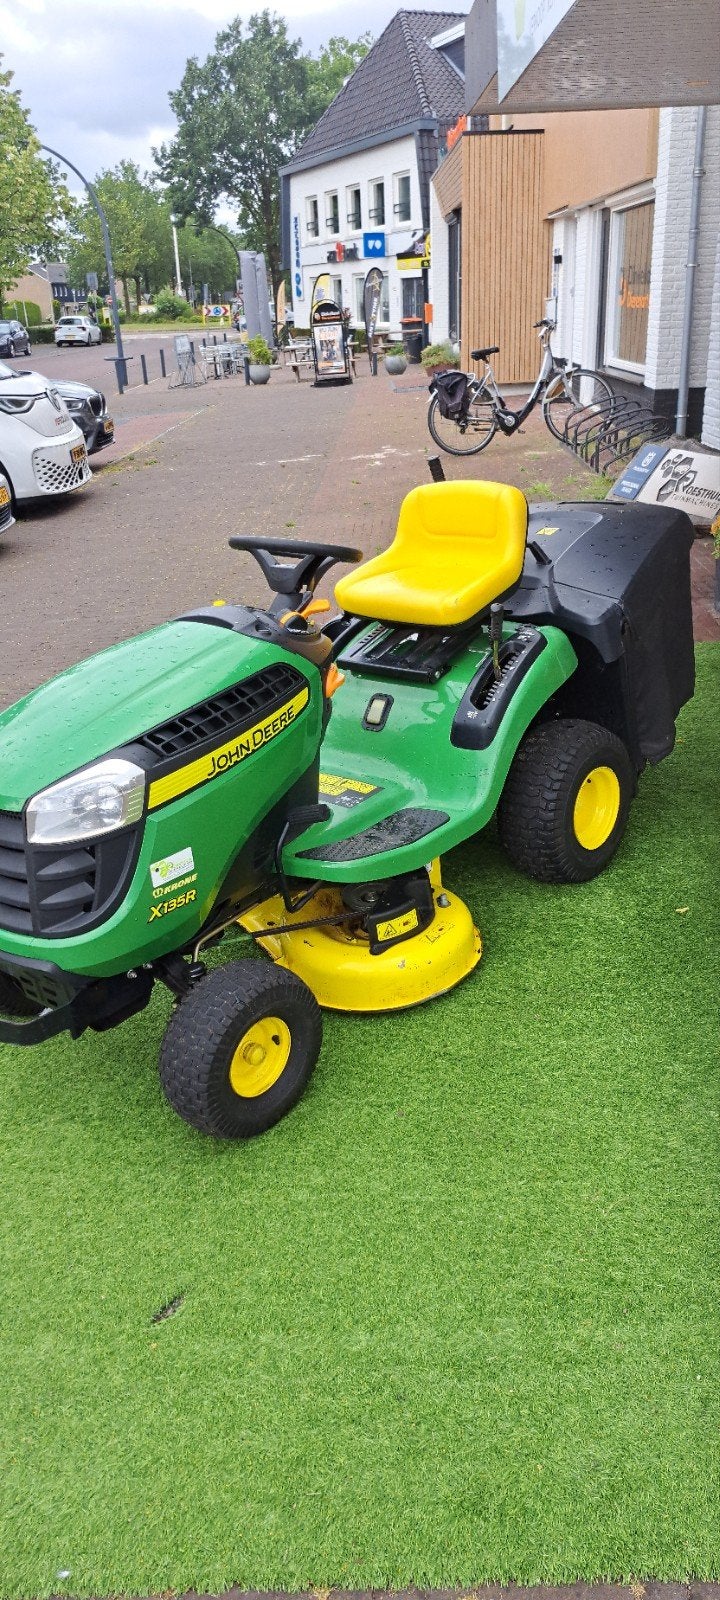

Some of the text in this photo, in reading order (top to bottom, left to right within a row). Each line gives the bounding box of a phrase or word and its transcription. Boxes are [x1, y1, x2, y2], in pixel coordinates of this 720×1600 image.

[207, 705, 296, 777] JOHN DEERE
[164, 873, 198, 895] KRONE
[148, 889, 197, 923] X135R
